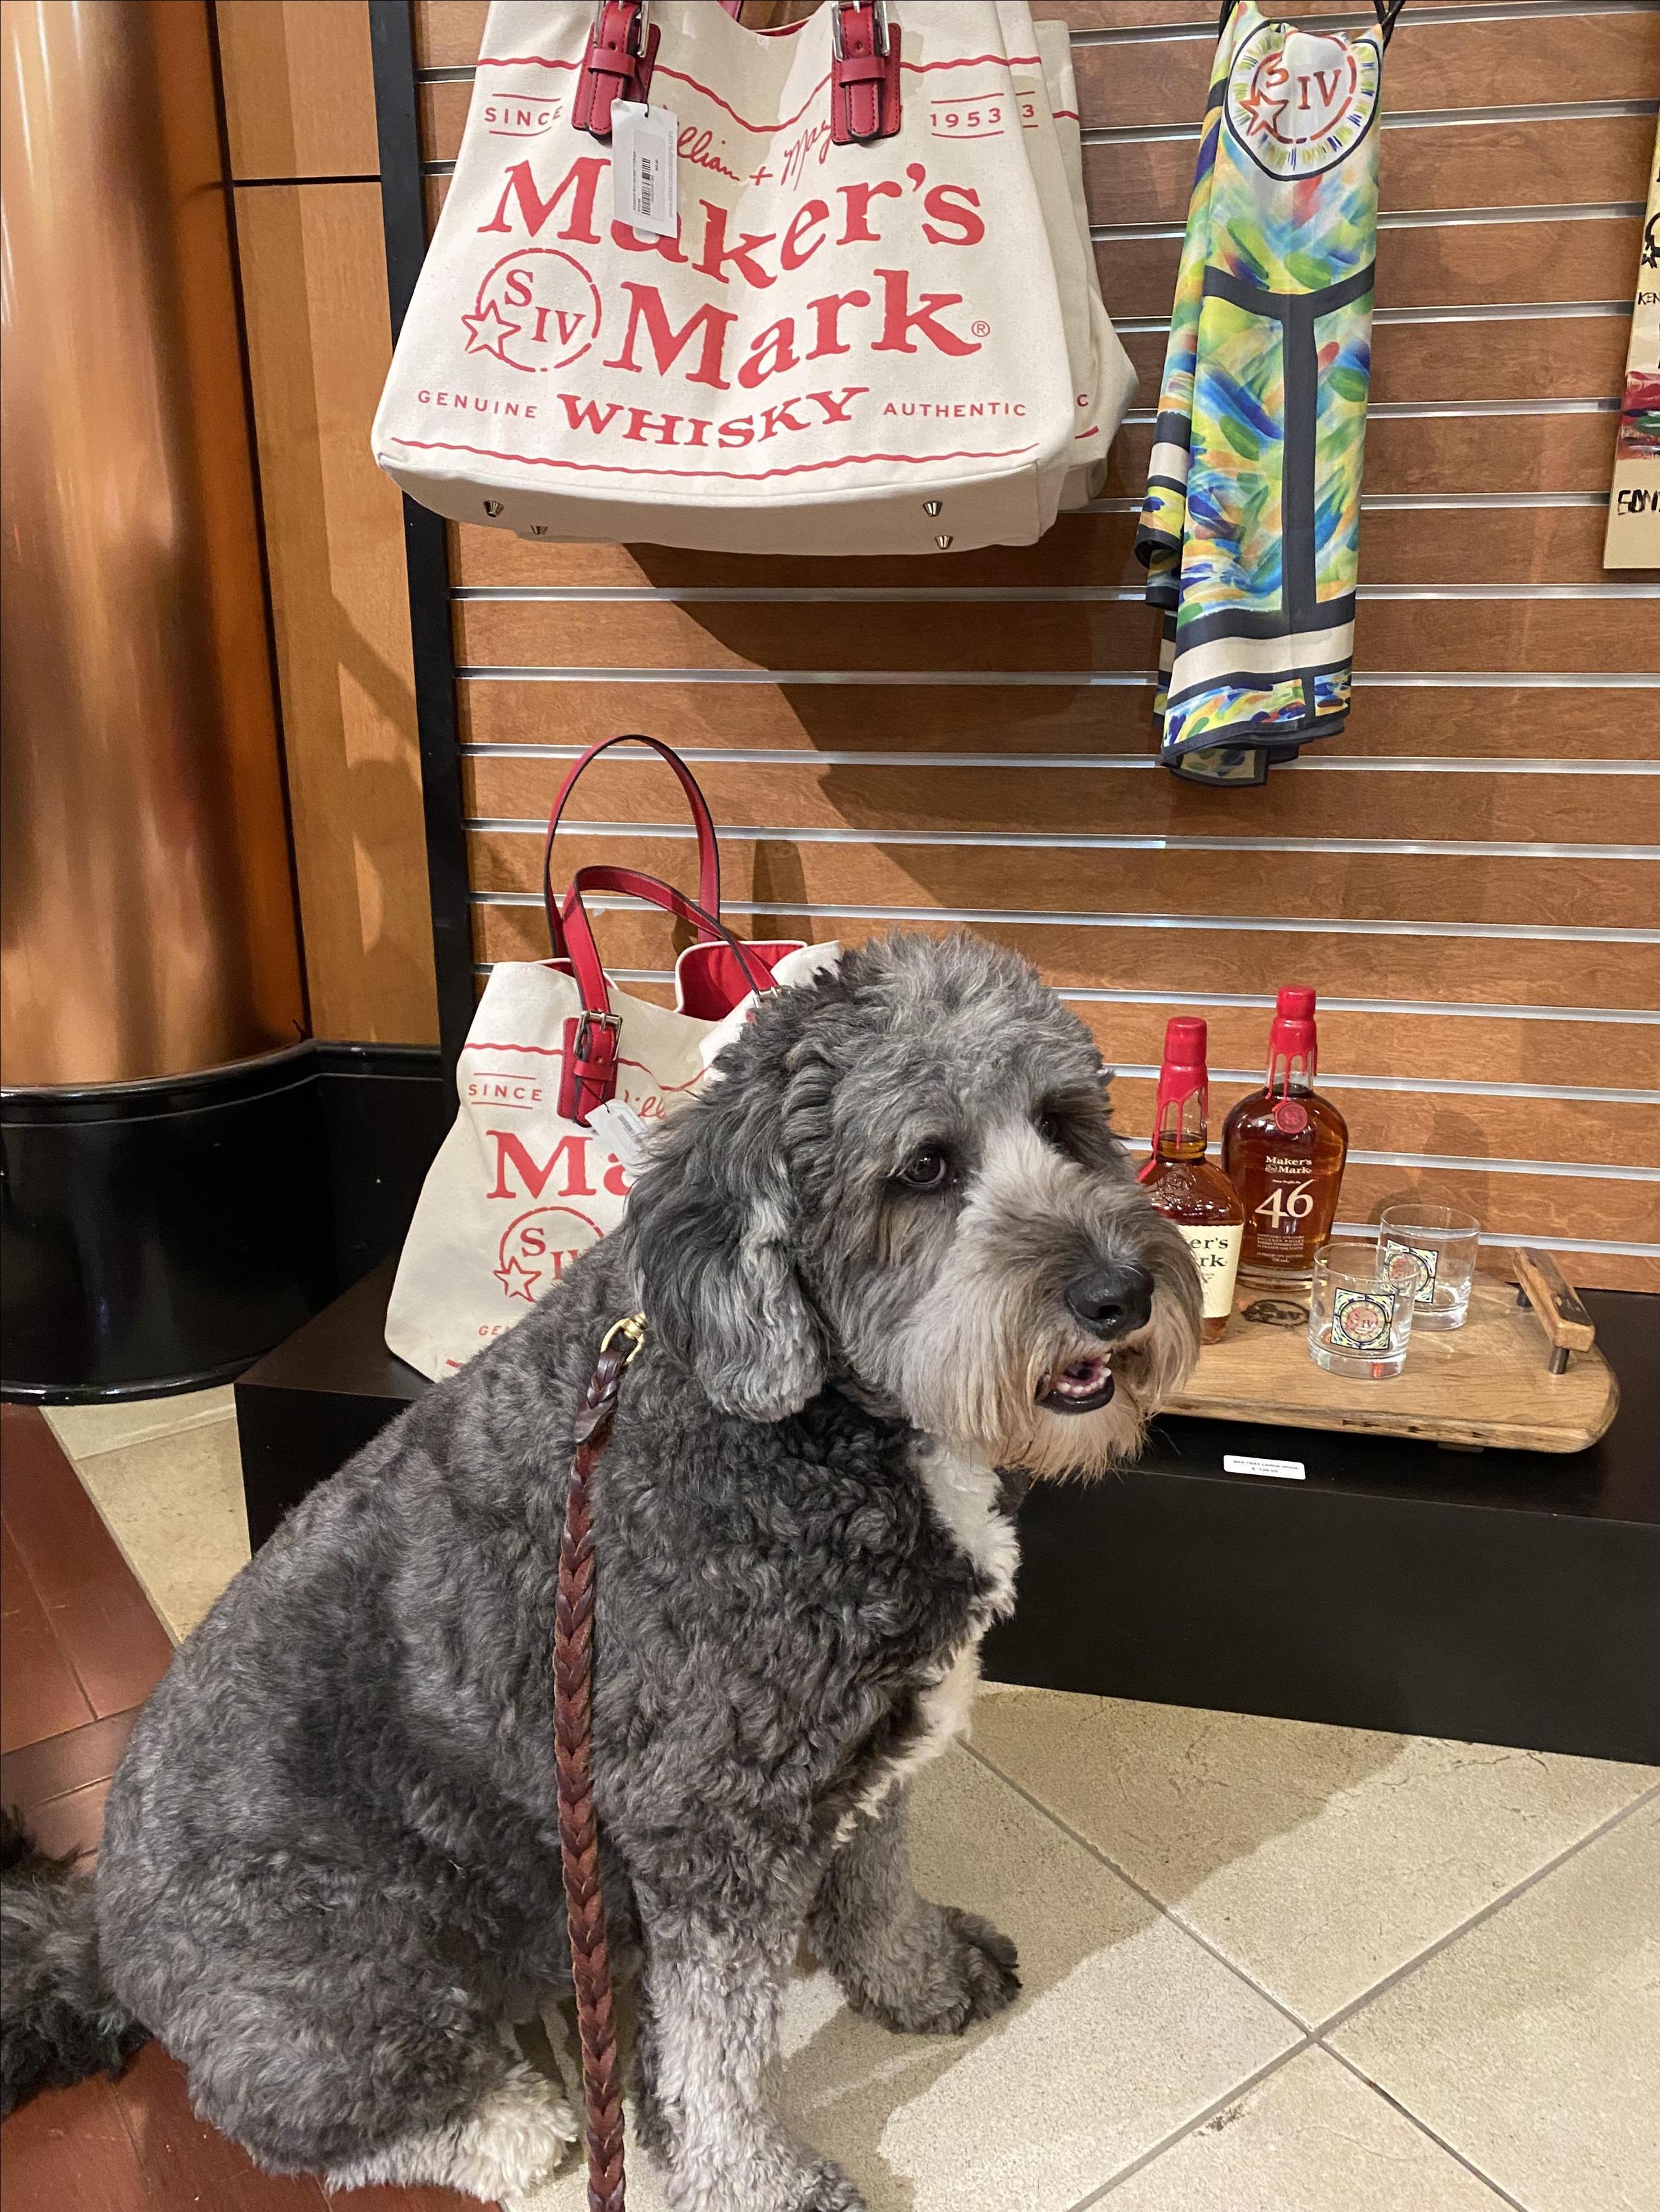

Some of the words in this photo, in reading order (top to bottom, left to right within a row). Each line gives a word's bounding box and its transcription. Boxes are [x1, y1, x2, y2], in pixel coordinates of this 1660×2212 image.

[1297, 69, 1342, 111] IV
[484, 105, 564, 127] SINCE
[930, 106, 1002, 129] 1953
[476, 156, 986, 290] Maker's
[531, 306, 585, 346] IV
[418, 389, 538, 419] GENUINE
[556, 387, 870, 449] WHISKY
[883, 401, 1026, 418] AUTHENTIC
[468, 1084, 543, 1102] SINCE
[1265, 1155, 1313, 1166] Maker's
[1254, 1178, 1317, 1229] 46
[1190, 1237, 1229, 1249] er's
[1199, 1254, 1227, 1267] rk
